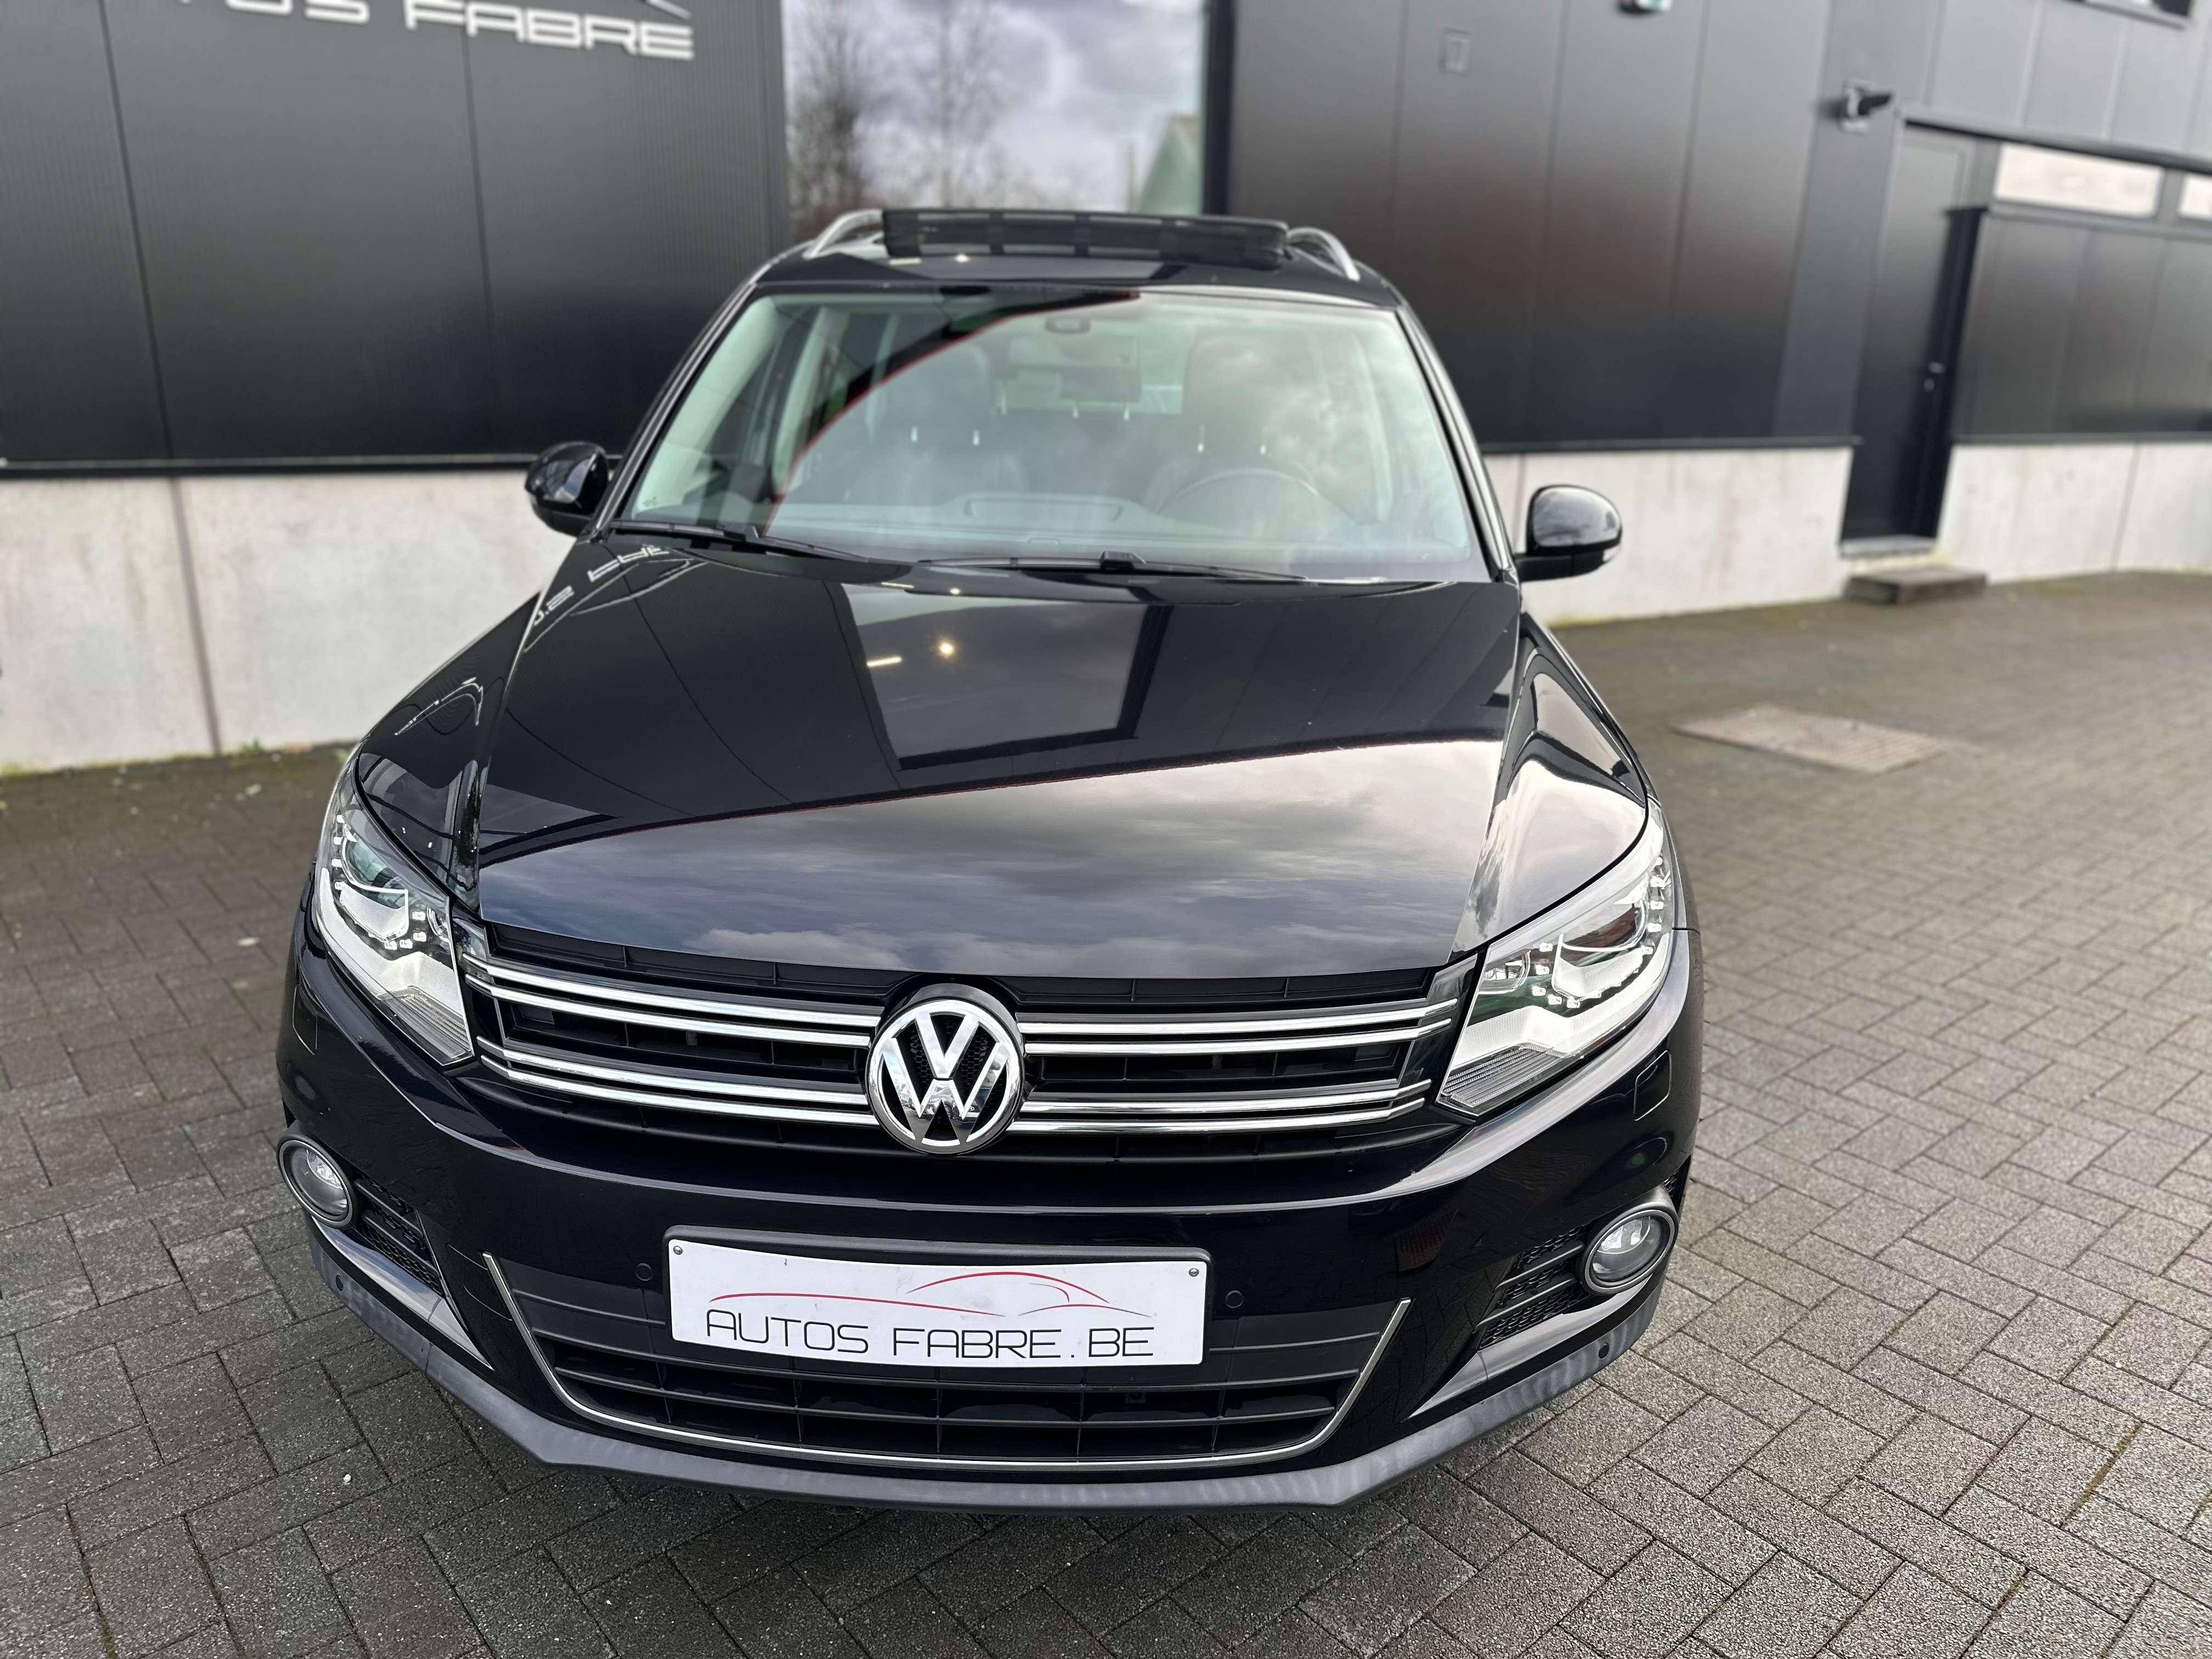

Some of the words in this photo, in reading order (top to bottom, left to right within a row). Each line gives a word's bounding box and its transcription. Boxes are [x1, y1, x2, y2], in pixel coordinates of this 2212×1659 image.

[404, 0, 695, 60] FABRE
[879, 1011, 1013, 1147] VW
[706, 1309, 868, 1353] AUTOS
